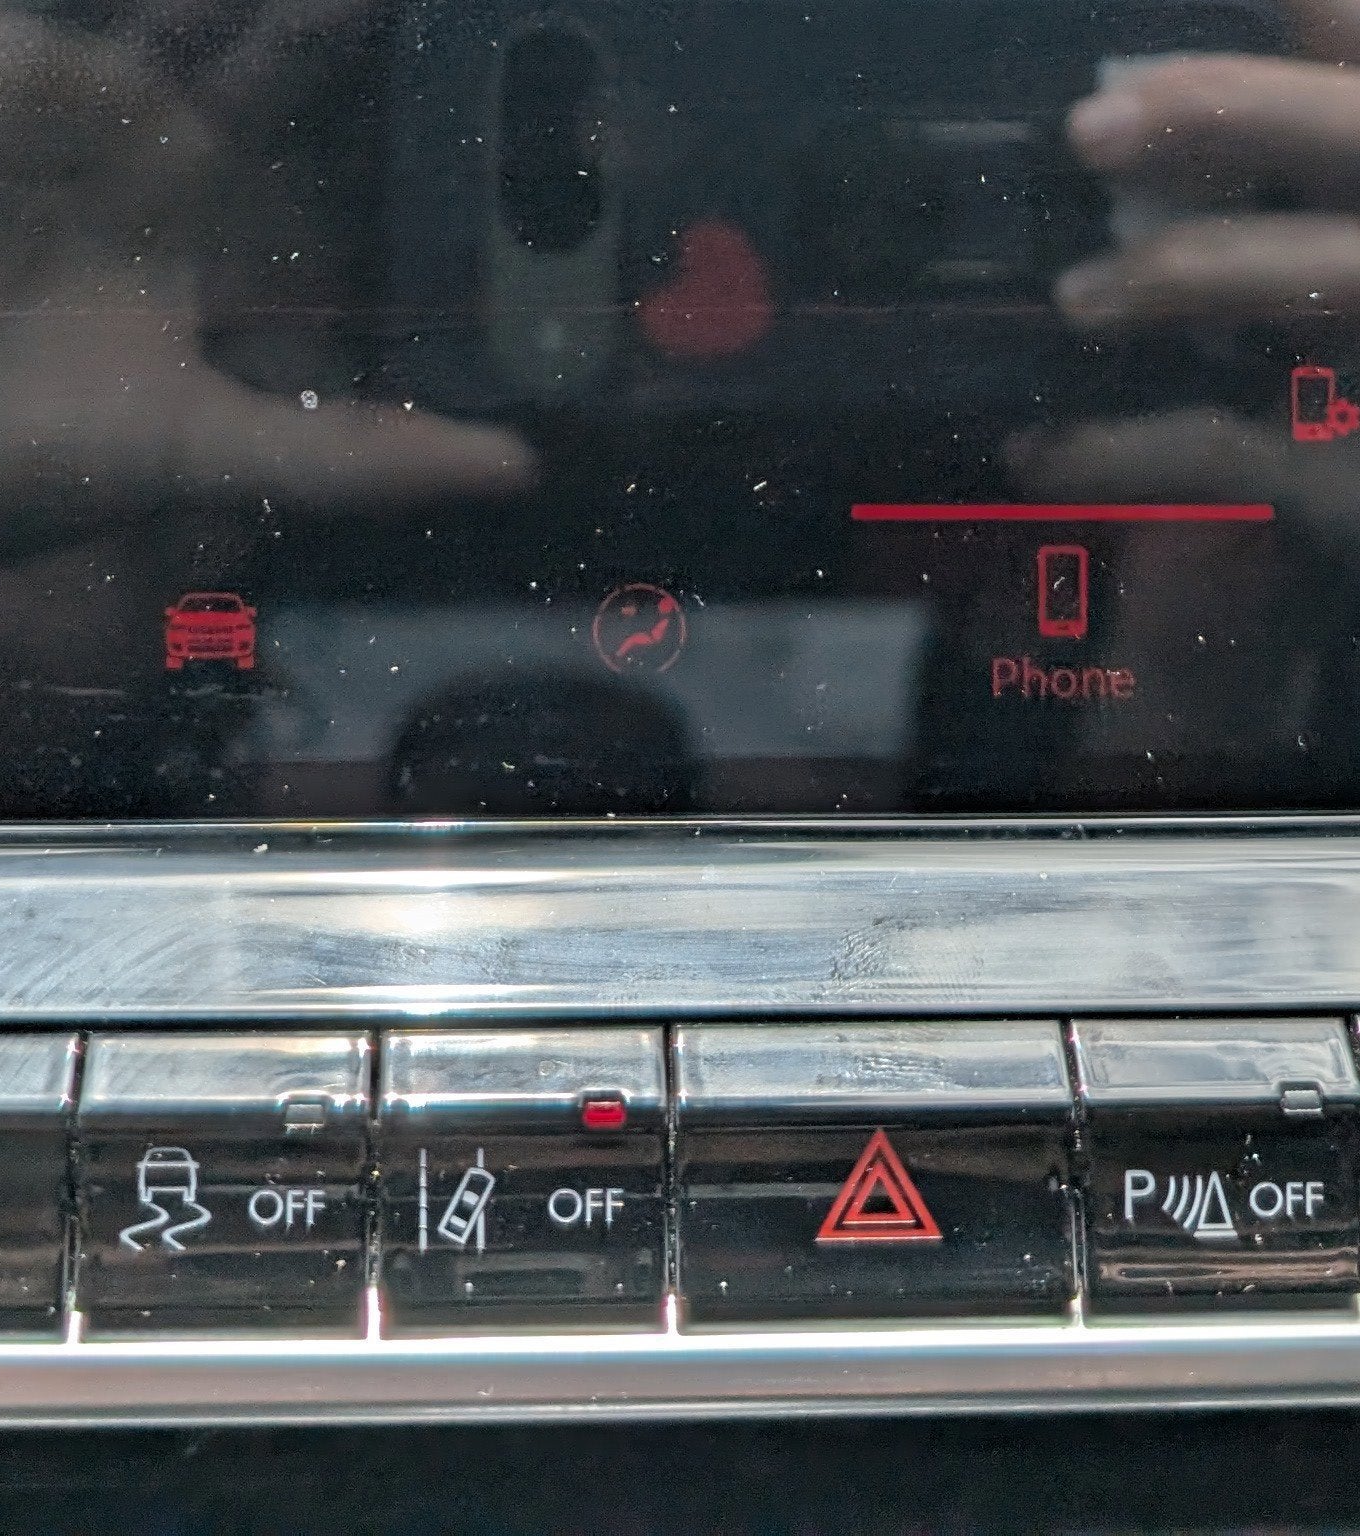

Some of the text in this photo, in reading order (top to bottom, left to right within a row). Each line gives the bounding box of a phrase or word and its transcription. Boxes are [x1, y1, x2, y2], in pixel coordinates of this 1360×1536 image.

[990, 654, 1137, 701] Phone
[248, 1188, 327, 1228] OFF
[548, 1187, 625, 1228] OFF
[1248, 1181, 1325, 1217] OFF
